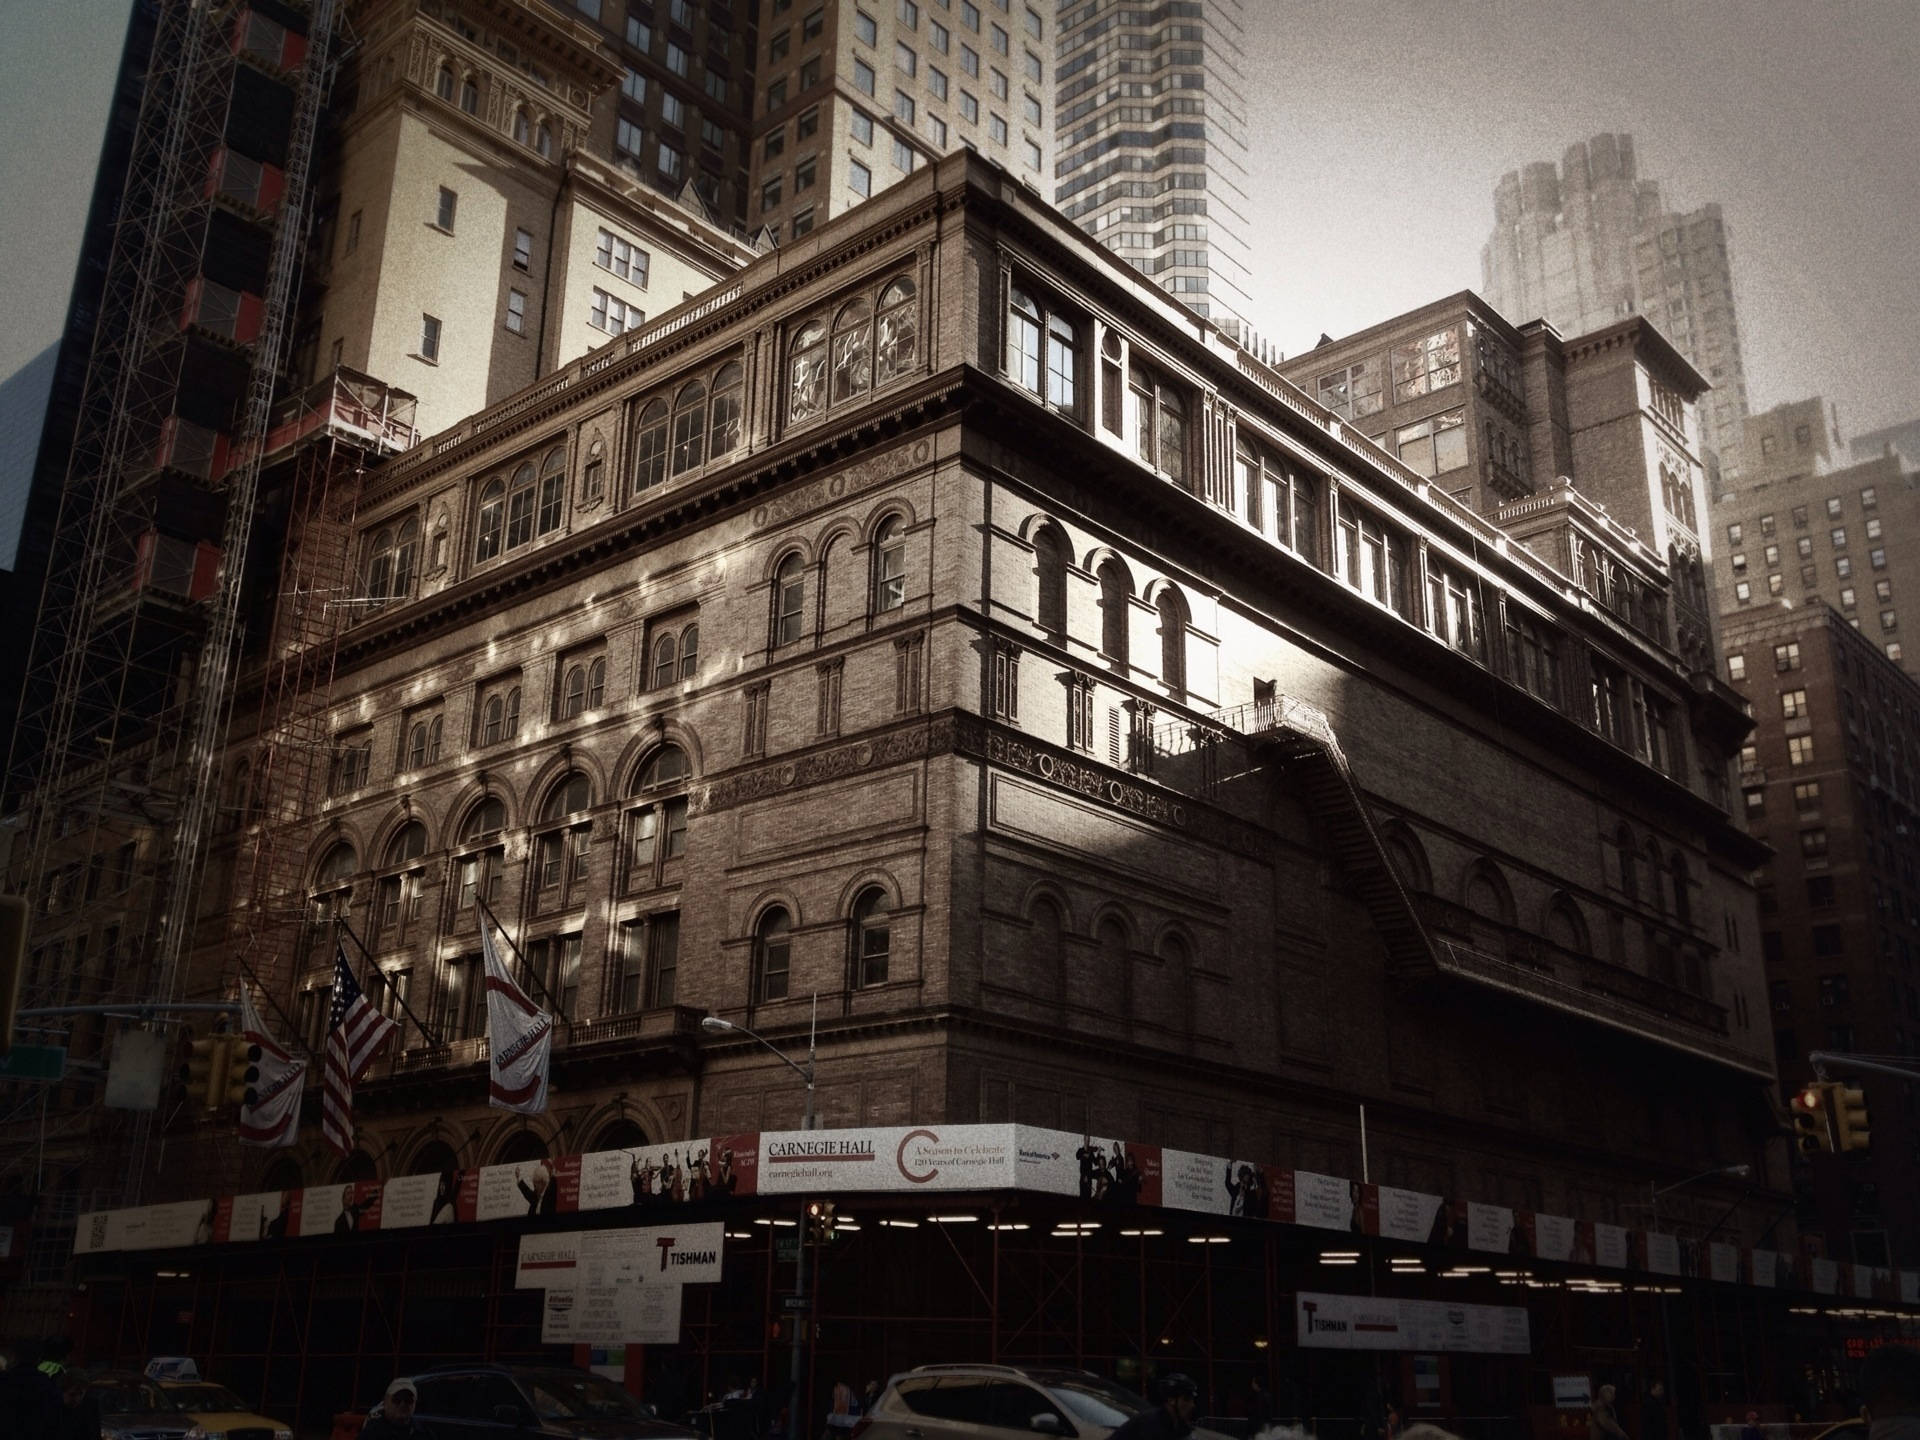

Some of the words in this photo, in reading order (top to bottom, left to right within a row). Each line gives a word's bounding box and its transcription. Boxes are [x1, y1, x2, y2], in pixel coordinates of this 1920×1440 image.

[528, 1018, 551, 1040] HALL
[769, 1141, 837, 1156] CARNEGIE
[840, 1140, 876, 1154] HALL
[915, 1145, 922, 1155] A
[923, 1146, 954, 1155] Season
[955, 1145, 963, 1155] to
[964, 1143, 1006, 1154] Celebrate
[914, 1158, 927, 1167] 120
[928, 1157, 948, 1166] Years
[956, 1157, 987, 1167] Carnegie
[988, 1156, 1006, 1166] Hall
[769, 1167, 833, 1179] carnegiehall.org
[671, 1251, 716, 1265] TISHMAN
[1314, 1319, 1348, 1332] TISHMAN
